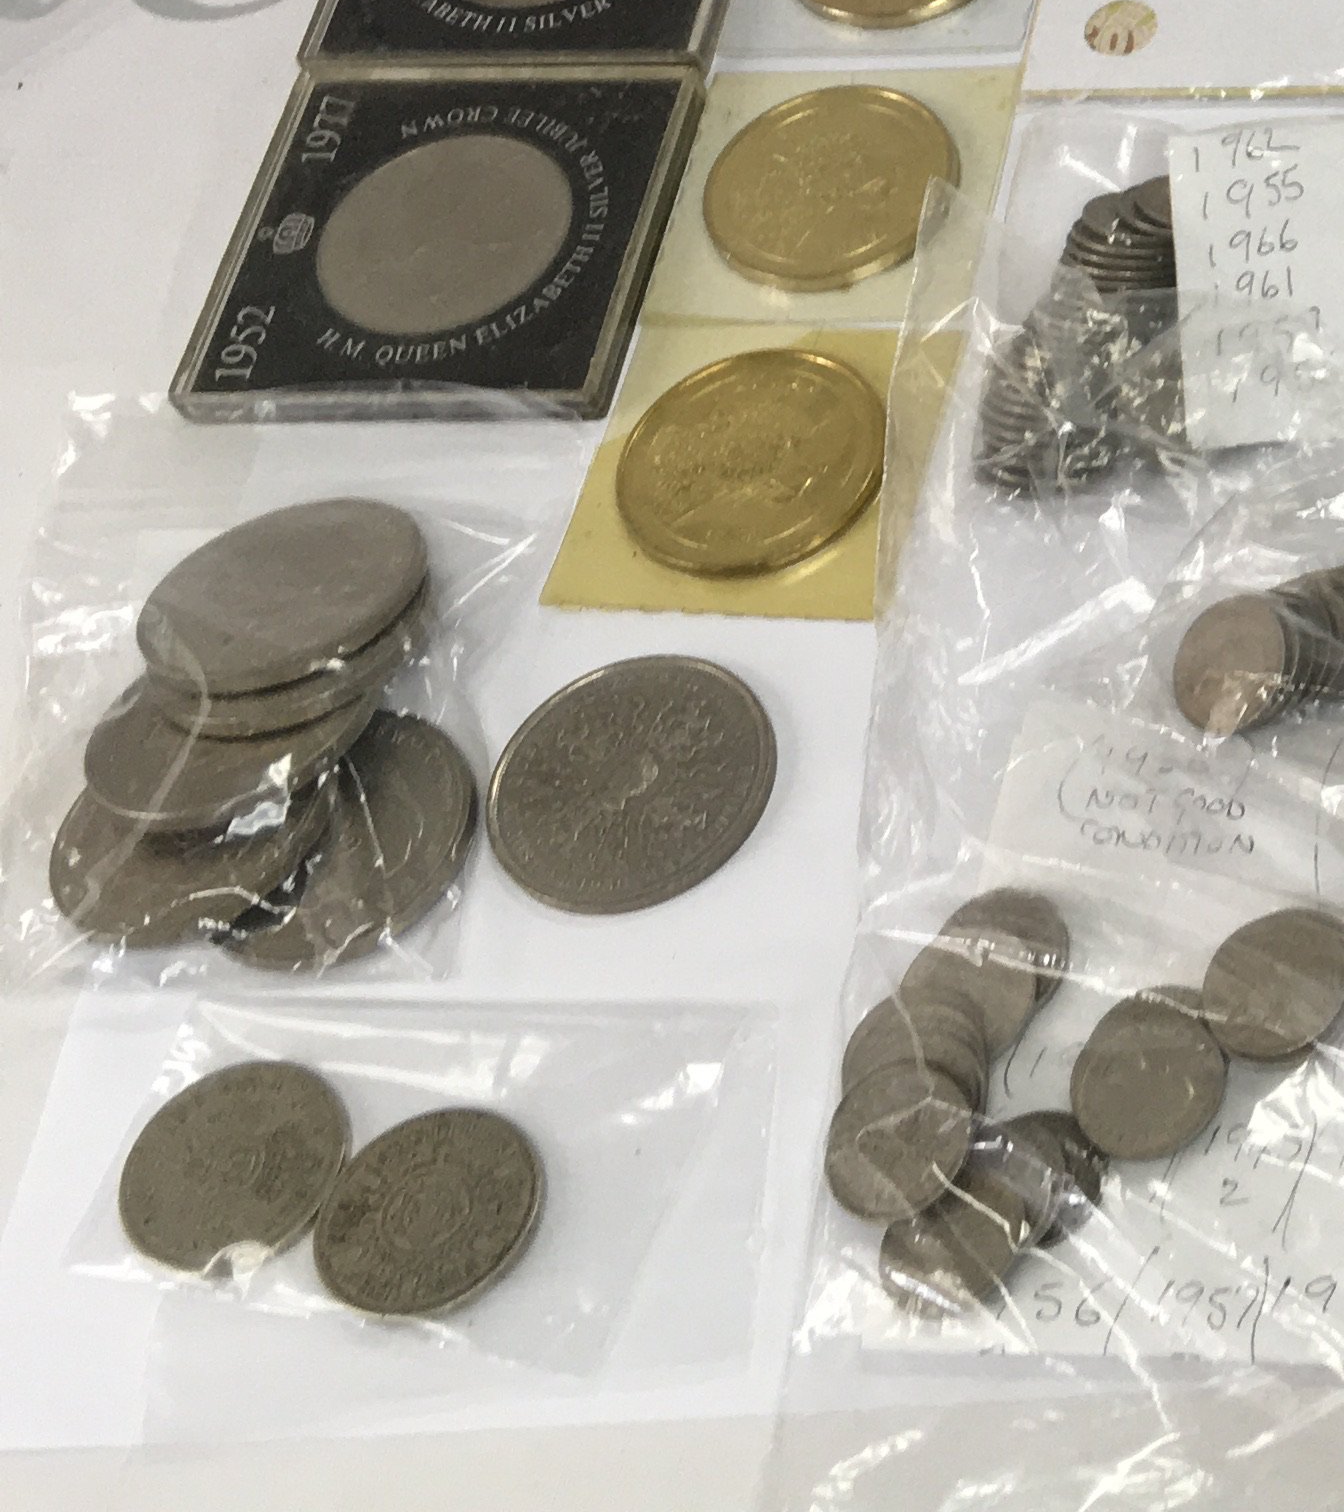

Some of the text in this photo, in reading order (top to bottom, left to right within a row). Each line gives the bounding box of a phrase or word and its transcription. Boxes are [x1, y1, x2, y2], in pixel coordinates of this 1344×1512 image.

[301, 94, 356, 164] 1977
[401, 105, 499, 141] CROWN
[579, 148, 610, 220] SILVER
[473, 244, 594, 347] ELIZABETH
[214, 304, 276, 384] 1952
[375, 334, 468, 368] QUEEN
